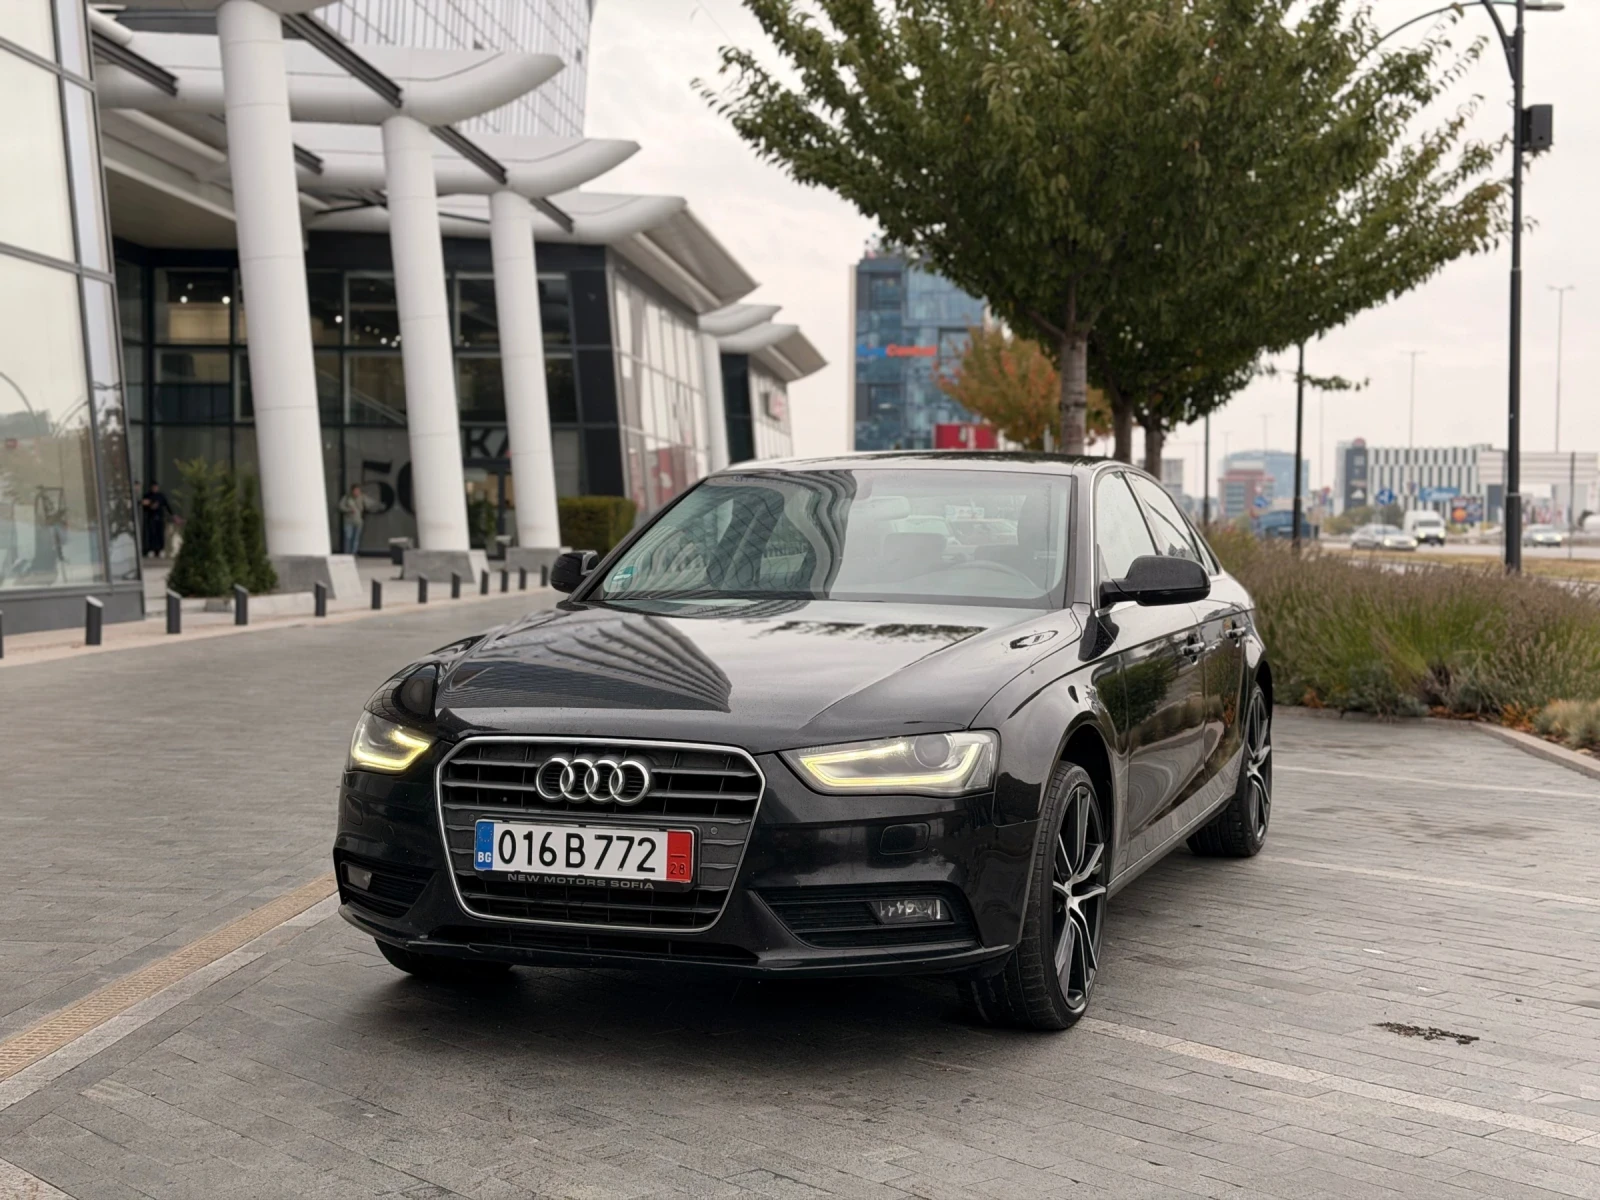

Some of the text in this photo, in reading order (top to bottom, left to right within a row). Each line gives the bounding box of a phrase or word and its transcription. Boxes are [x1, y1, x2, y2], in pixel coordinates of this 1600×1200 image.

[477, 851, 492, 863] BG
[669, 862, 686, 876] 28
[507, 873, 655, 890] NEW MOTORS SOFIA
